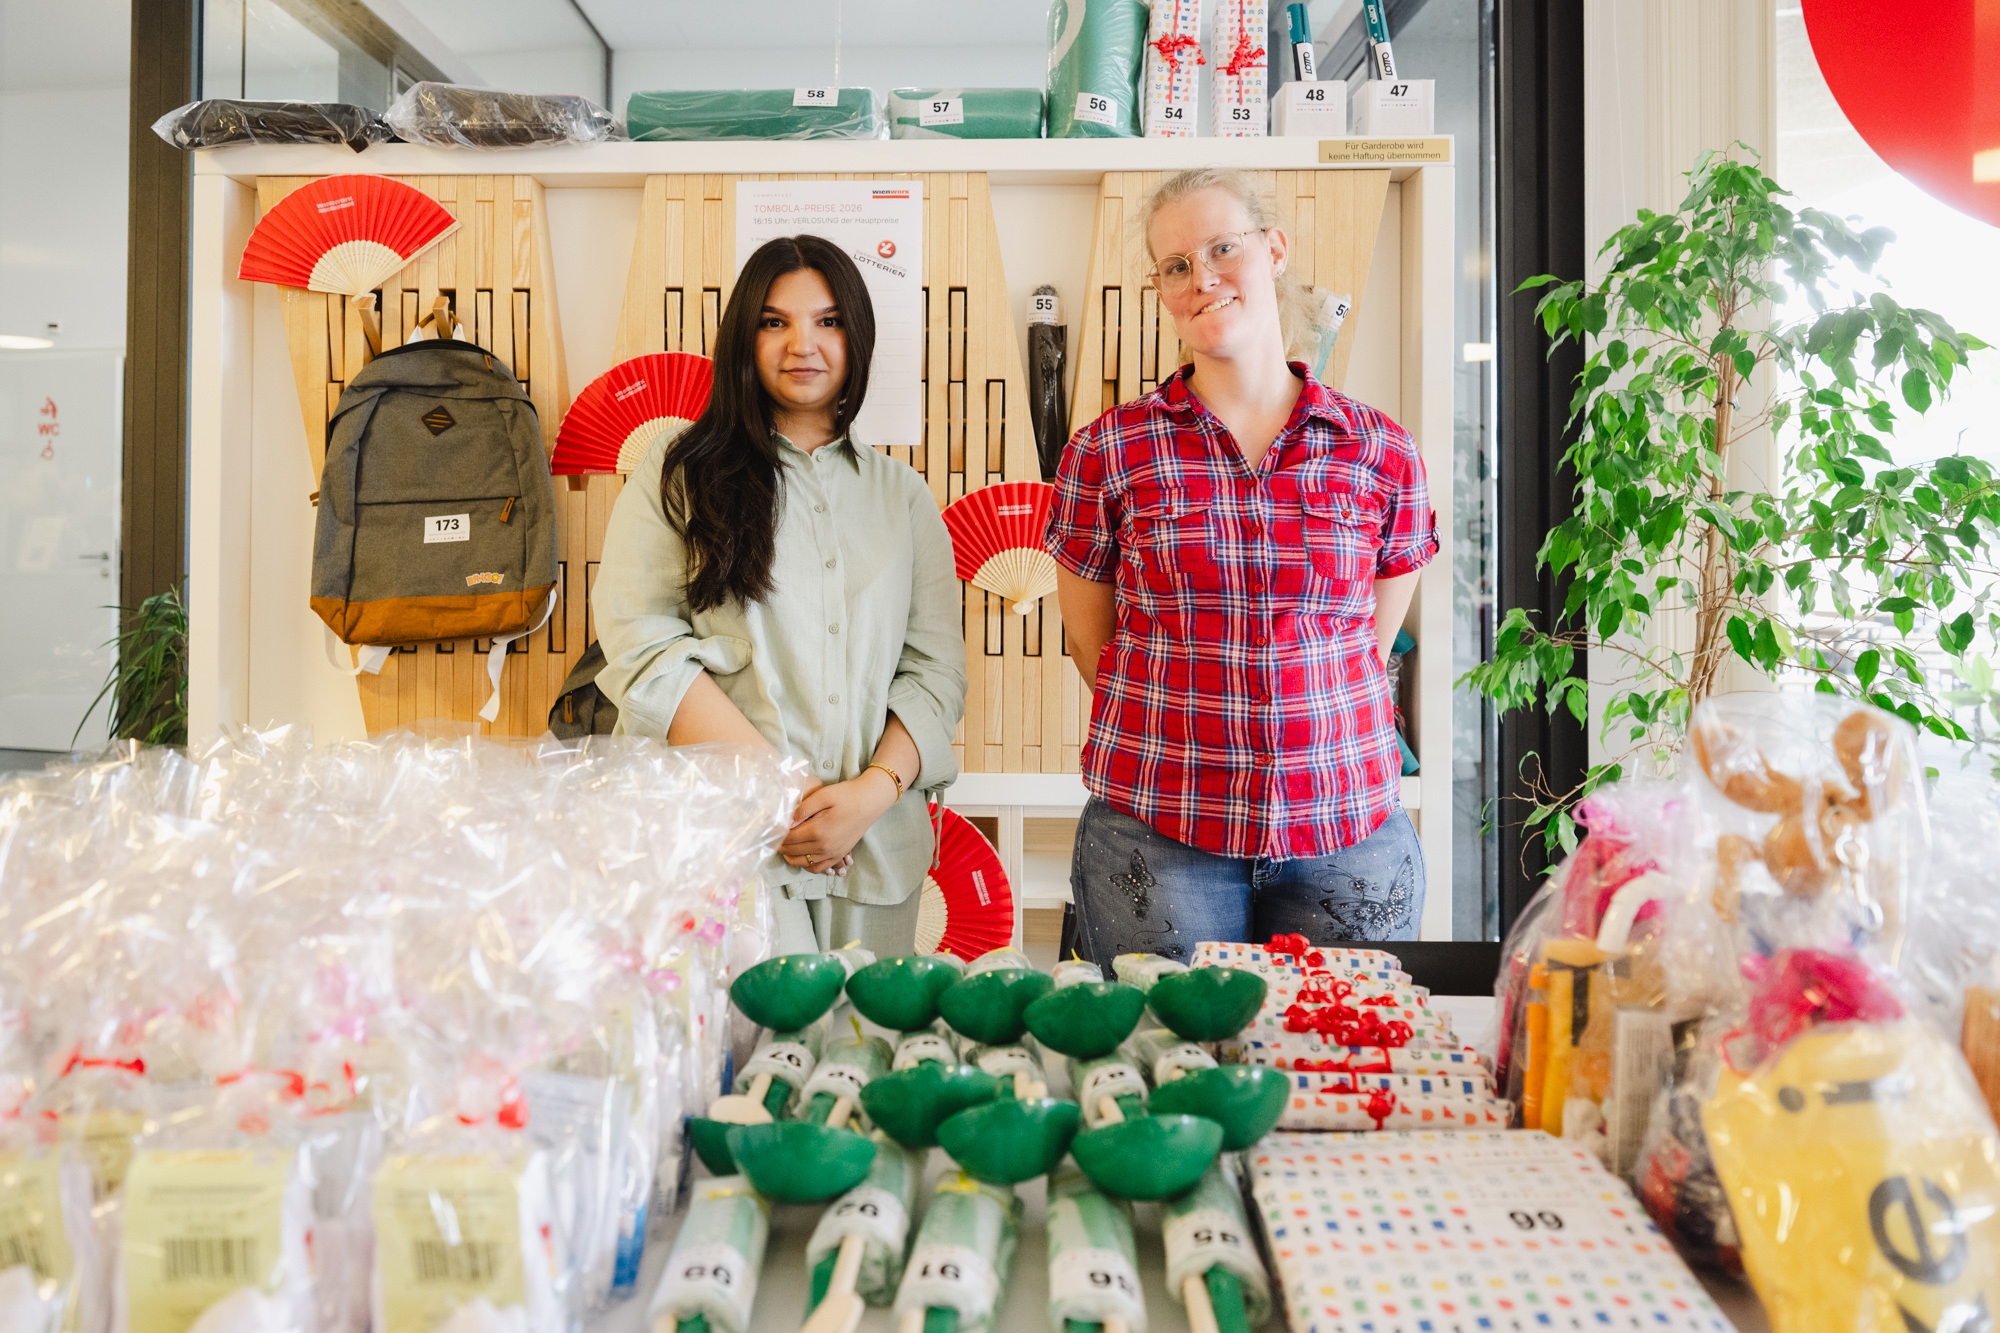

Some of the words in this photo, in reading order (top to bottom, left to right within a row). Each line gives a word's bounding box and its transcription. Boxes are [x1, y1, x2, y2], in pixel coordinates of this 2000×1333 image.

[1367, 4, 1378, 25] LOTTO
[1303, 51, 1313, 75] LOTTO
[1382, 52, 1393, 76] LOTTO
[807, 90, 825, 98] 58
[1305, 89, 1325, 101] 48
[1390, 85, 1408, 97] 47
[933, 102, 949, 113] 57
[1089, 98, 1107, 111] 56
[1165, 107, 1183, 119] 54
[1232, 108, 1250, 120] 53
[1353, 152, 1385, 161] Haftung
[1387, 152, 1441, 160] übernommen
[754, 204, 836, 213] TOMBOLA-PREISE
[839, 204, 863, 213] 2026
[855, 217, 899, 225] Hauptpreise
[853, 254, 906, 278] LOTTERIEN
[1036, 299, 1052, 310] 55
[38, 422, 60, 437] WC
[436, 519, 460, 531] 173
